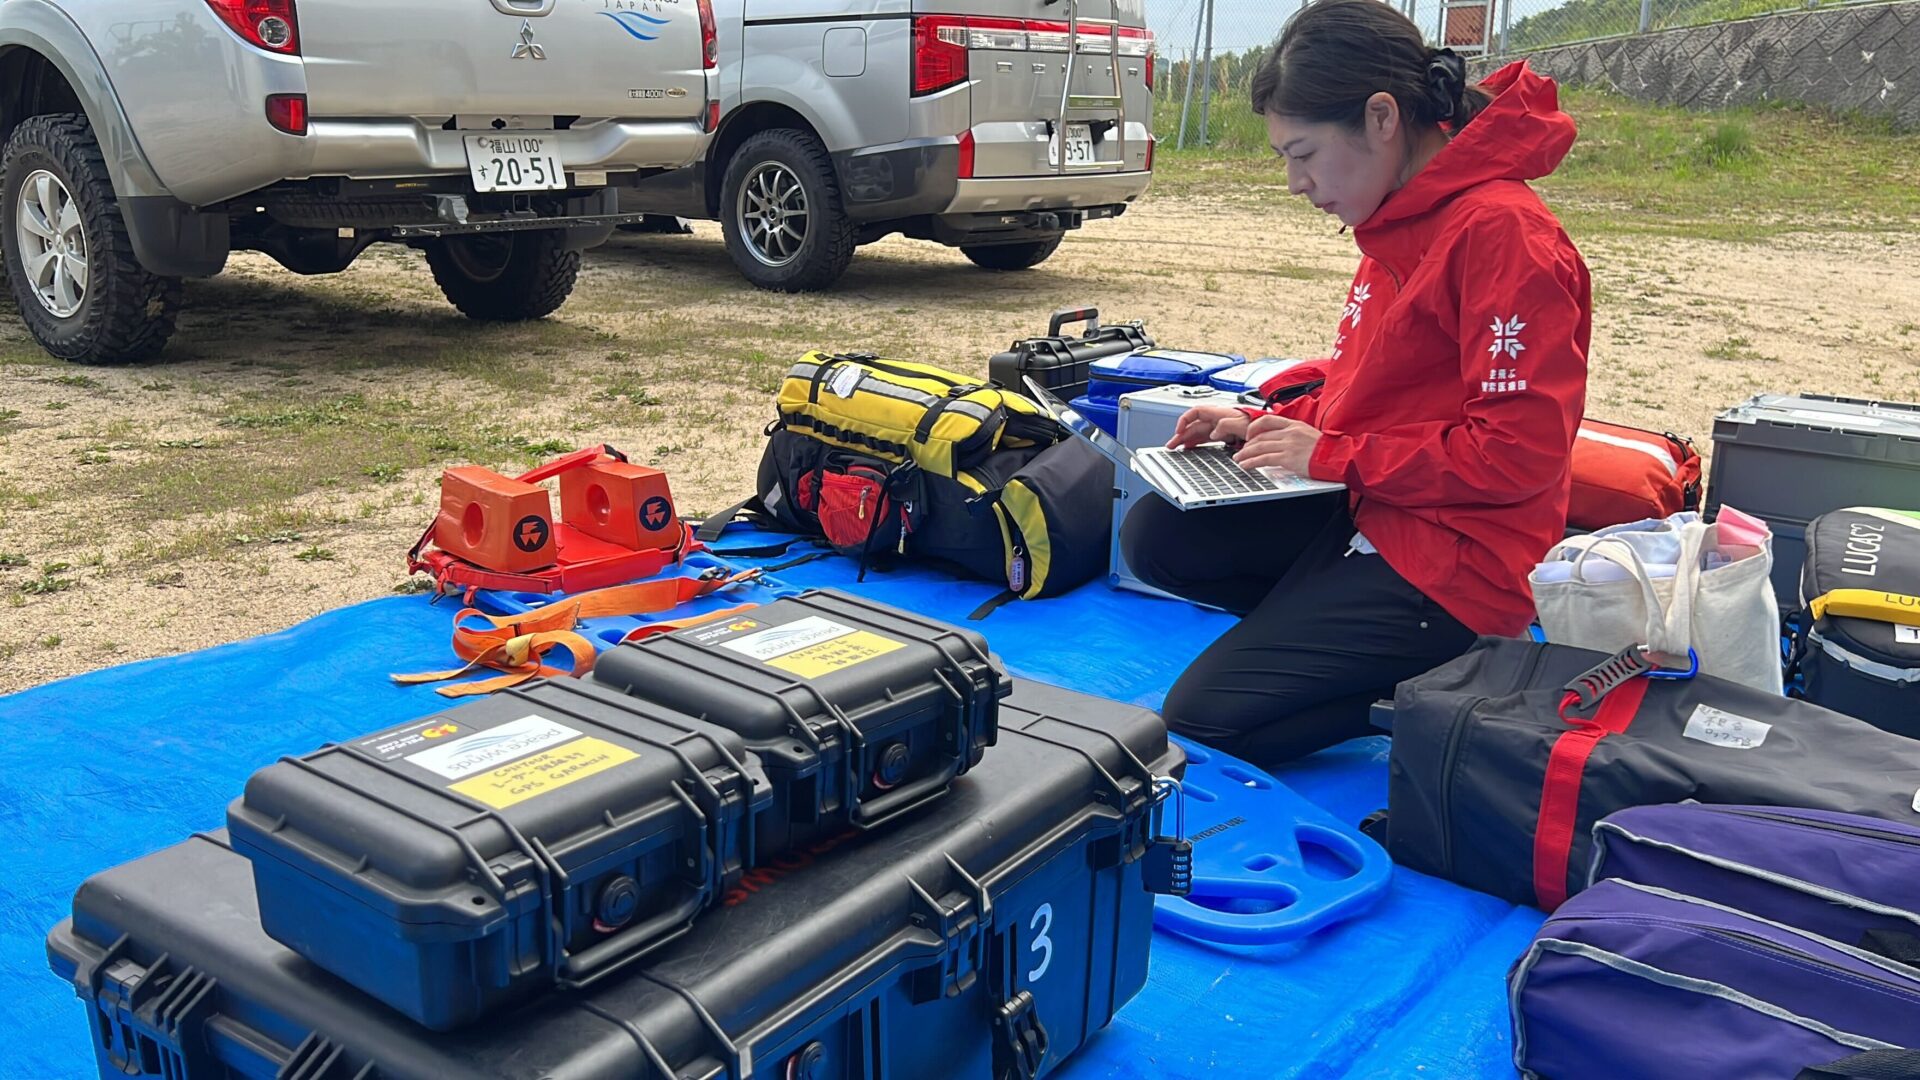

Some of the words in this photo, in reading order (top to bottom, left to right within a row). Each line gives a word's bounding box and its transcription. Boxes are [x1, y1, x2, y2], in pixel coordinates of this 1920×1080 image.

[604, 0, 662, 12] JAPAN
[491, 156, 558, 187] 20-51
[1885, 594, 1920, 606] LU
[504, 727, 562, 752] peace
[446, 744, 504, 772] winds
[510, 780, 545, 796] GPS
[1028, 902, 1053, 982] 3
